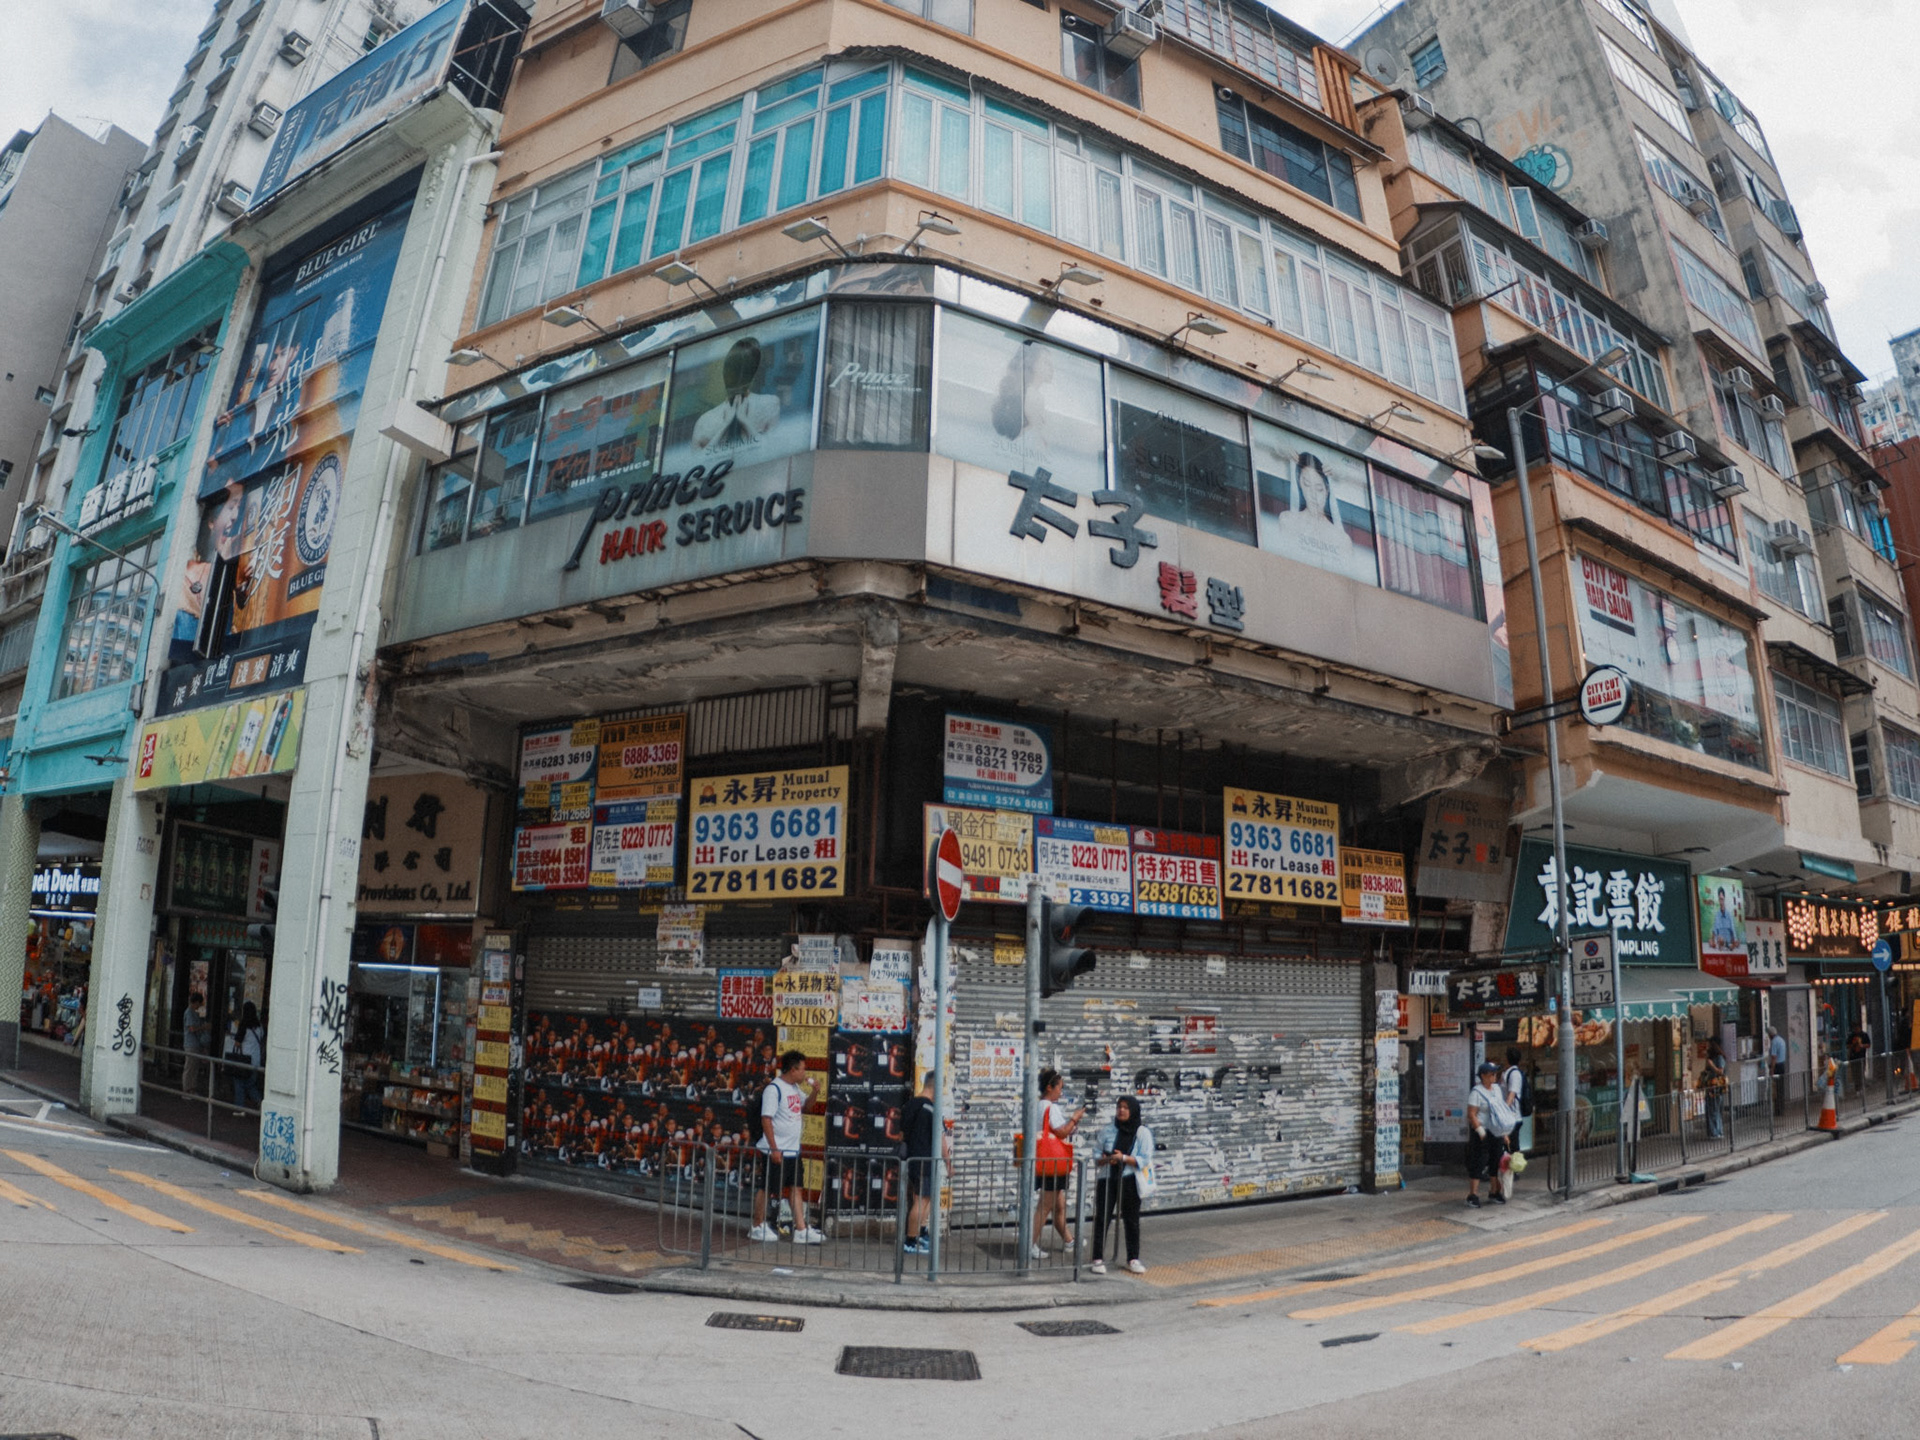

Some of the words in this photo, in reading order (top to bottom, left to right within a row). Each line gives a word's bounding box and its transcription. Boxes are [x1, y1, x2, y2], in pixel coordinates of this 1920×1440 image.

[262, 152, 281, 192] BLUE
[280, 109, 301, 150] GIRL
[295, 251, 334, 283] BLUE
[336, 224, 377, 256] GIRL
[829, 362, 911, 388] Prince
[571, 476, 597, 488] Hair
[601, 460, 650, 479] Service
[1155, 474, 1181, 490] Beauty
[600, 519, 668, 565] HAIR
[676, 488, 805, 547] SERVICE
[289, 572, 313, 595] BLUE
[313, 569, 325, 581] GI
[1582, 556, 1606, 587] CITY
[1608, 568, 1629, 597] CUT
[1584, 580, 1607, 612] HAIR
[1606, 589, 1634, 624] SALON
[1586, 682, 1603, 696] CITY
[1604, 677, 1619, 692] CUT
[1587, 695, 1602, 707] HAIR
[1602, 688, 1621, 703] SALON
[541, 755, 564, 769] 6283
[568, 750, 592, 765] 3619
[624, 743, 678, 765] 6888-3369
[975, 744, 1007, 759] 6372
[1011, 750, 1042, 763] 9268
[975, 756, 1006, 770] 6821
[1012, 761, 1042, 775] 1762
[722, 776, 778, 805] 永昇
[782, 770, 829, 786] Mutual
[781, 786, 841, 801] Property
[995, 795, 1021, 807] 2576
[1024, 798, 1049, 810] 8081
[1251, 795, 1293, 822] 永昇
[1295, 802, 1328, 815] Mutual
[695, 811, 759, 843] 9363
[770, 806, 836, 838] 6681
[1296, 814, 1335, 829] Property
[594, 829, 620, 850] 何先生
[621, 827, 644, 849] 8228
[647, 823, 673, 847] 0773
[1230, 821, 1282, 852] 9363
[1290, 830, 1334, 858] 6681
[695, 845, 714, 864] 出
[719, 845, 748, 863] For
[755, 844, 810, 862] Lease
[814, 837, 836, 859] 租
[962, 843, 992, 868] 9481
[997, 846, 1029, 872] 0733
[1039, 841, 1070, 866] 何先生
[1072, 845, 1098, 869] 8228
[1101, 848, 1127, 872] 0773
[1137, 854, 1217, 885] 特約租售
[1231, 850, 1248, 867] 出
[1252, 853, 1275, 869] For
[1280, 856, 1319, 874] Lease
[1321, 859, 1336, 877] 租
[31, 868, 51, 892] uck
[51, 868, 81, 892] Duck
[359, 883, 417, 901] Provisions
[446, 881, 473, 901] Ltd.
[691, 866, 837, 893] 27811682
[1229, 872, 1338, 901] 27811682
[1363, 875, 1403, 894] 9836-8802
[1089, 891, 1130, 906] 3392
[1138, 881, 1217, 906] 28381633
[1537, 856, 1665, 933] 袁記雲餃
[1139, 903, 1175, 916] 6181
[1182, 905, 1218, 918] 6119
[784, 975, 837, 992] 永昇物業
[1597, 974, 1605, 985] 7
[720, 995, 774, 1018] 55486228
[1599, 990, 1612, 1001] 12
[775, 1008, 835, 1026] 27811682
